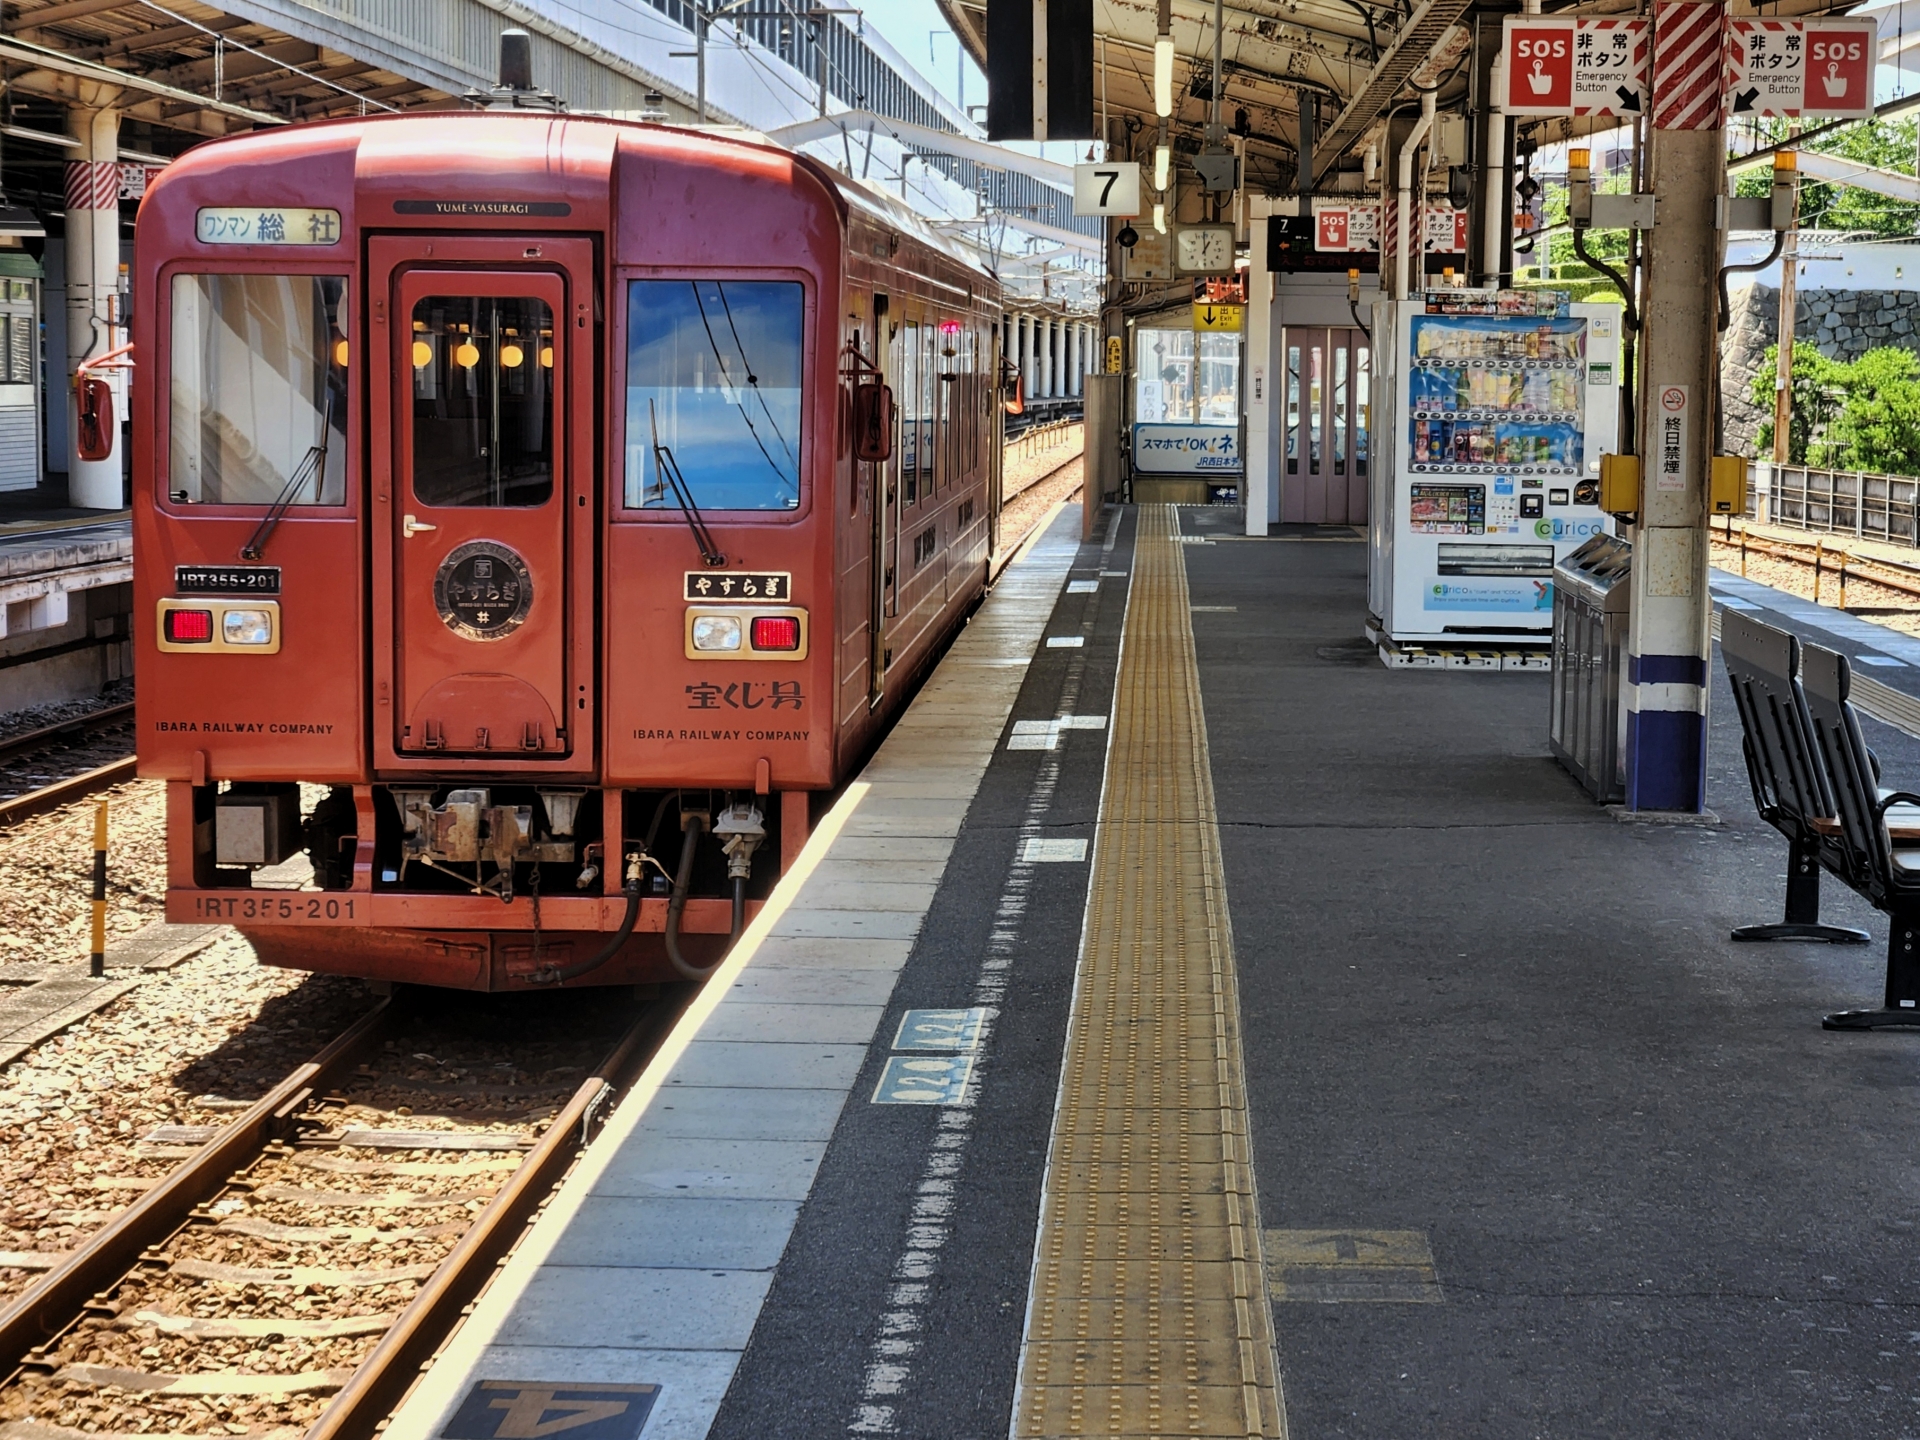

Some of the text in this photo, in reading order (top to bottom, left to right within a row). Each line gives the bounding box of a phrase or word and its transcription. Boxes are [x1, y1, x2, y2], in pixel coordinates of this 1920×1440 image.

[1577, 33, 1628, 50] 非常
[1750, 34, 1801, 51] 非常
[1518, 39, 1566, 58] SOS
[1813, 42, 1861, 61] SOS
[1577, 51, 1628, 68] ボタン
[1750, 53, 1801, 69] ボタン
[1576, 71, 1628, 82] Emergency
[1748, 73, 1800, 84] Emergency
[1576, 82, 1607, 92] Button
[1768, 84, 1800, 94] Button
[1094, 171, 1119, 207] 7
[436, 203, 529, 214] YUME-YASURAGI
[1280, 218, 1289, 231] 7
[1322, 216, 1345, 226] SOS
[1350, 214, 1373, 222] 非常
[204, 216, 251, 237] ワンマン
[257, 212, 336, 242] 総社
[1350, 222, 1374, 231] ボタン
[1429, 223, 1453, 231] ボタン
[1663, 417, 1681, 473] 終日禁煙
[1539, 521, 1602, 535] curico
[182, 574, 275, 587] IRT355-201
[695, 578, 780, 596] やすらぎ
[448, 582, 518, 601] やすらぎ
[1434, 586, 1468, 595] curico
[685, 681, 805, 710] 宝くじ号
[156, 722, 333, 734] IBARA RAILWAY COMPANY
[633, 730, 809, 740] IBARA RAILWAY COMPANY
